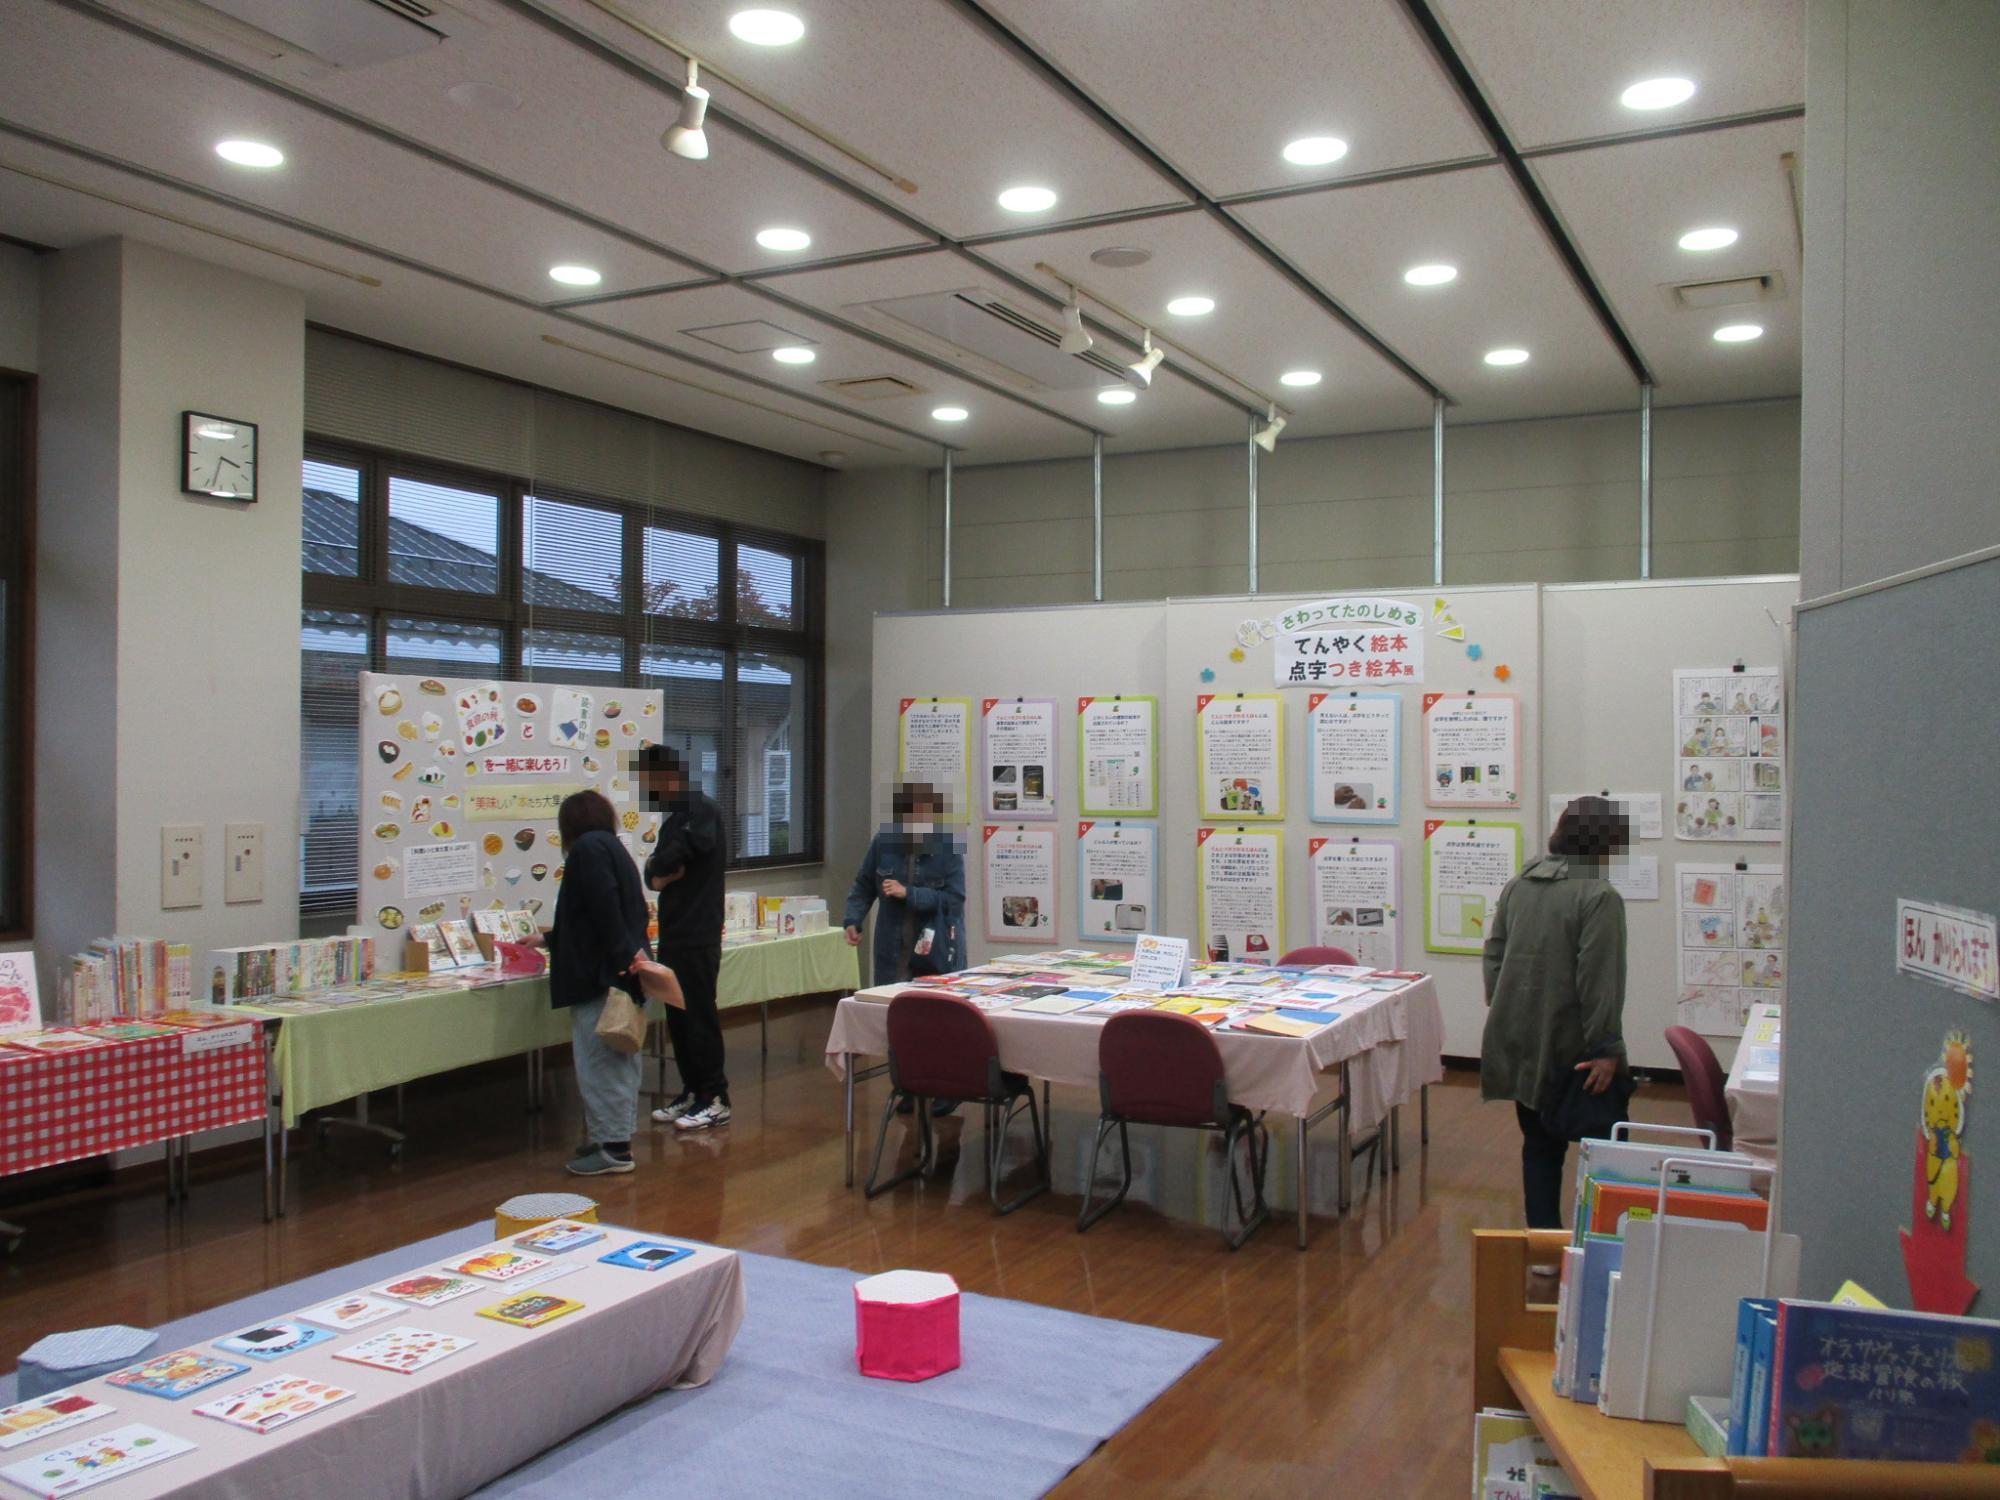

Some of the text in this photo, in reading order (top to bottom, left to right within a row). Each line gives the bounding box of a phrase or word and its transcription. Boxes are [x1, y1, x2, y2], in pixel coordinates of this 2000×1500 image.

[1282, 603, 1417, 630] さわってたのしめる
[1295, 633, 1408, 654] てんやく絵本
[1289, 659, 1414, 681] 点字つき絵本展
[523, 724, 533, 738] と
[484, 757, 569, 773] を一緒に楽しもう!
[1904, 916, 1990, 984] ほん かりられます
